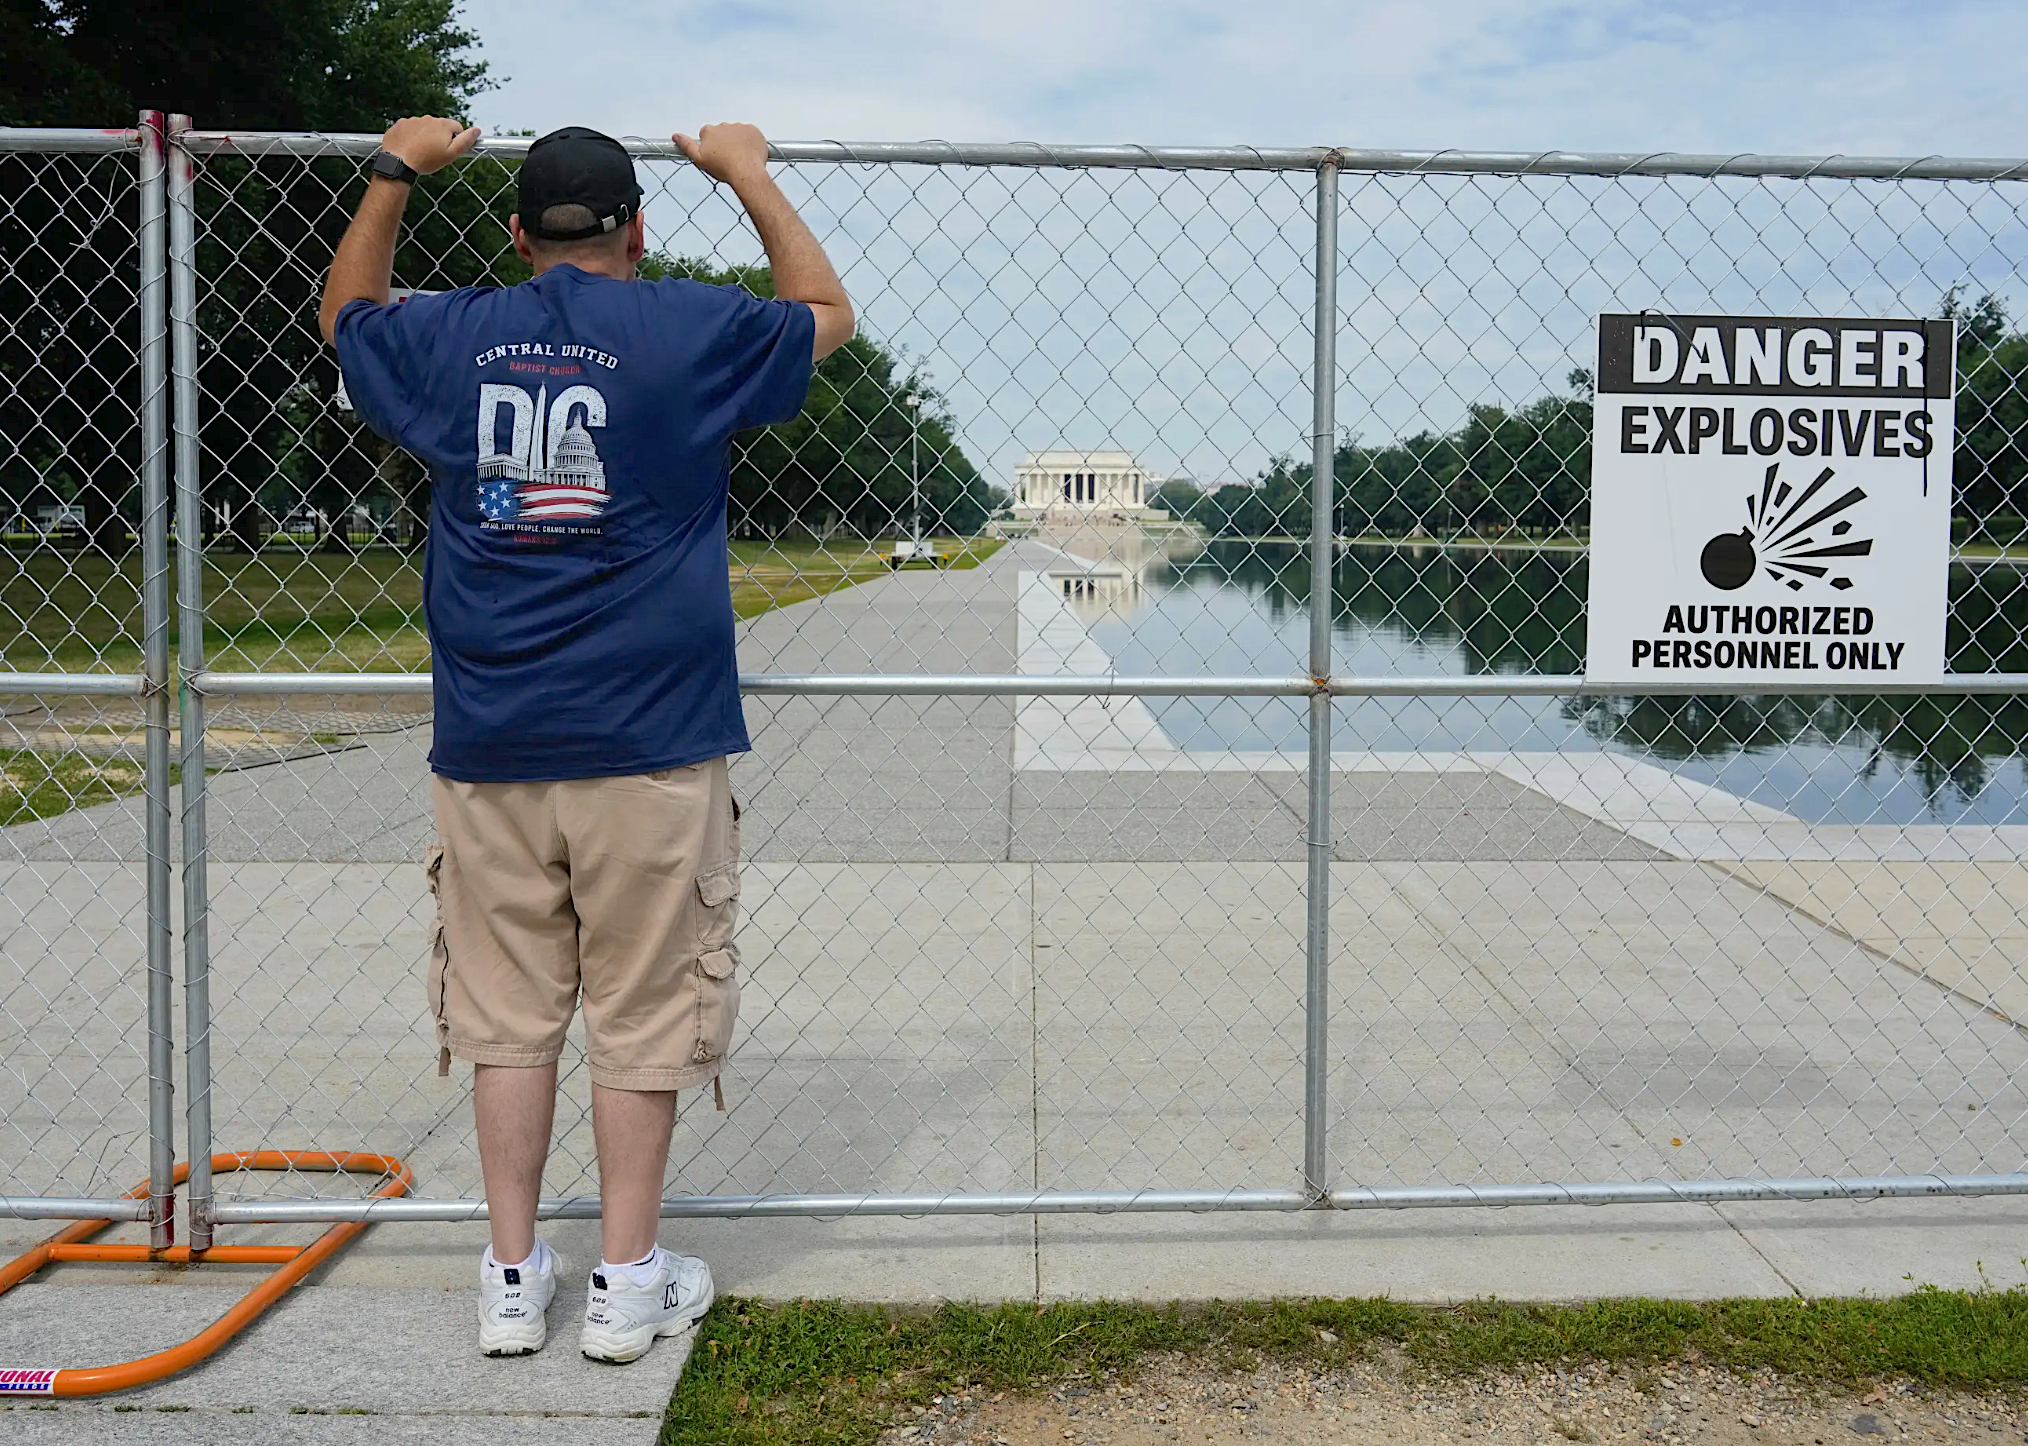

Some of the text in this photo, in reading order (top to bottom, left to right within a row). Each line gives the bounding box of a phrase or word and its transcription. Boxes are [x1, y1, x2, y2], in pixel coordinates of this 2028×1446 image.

[475, 342, 619, 370] CENTRAL UNITED
[509, 361, 582, 375] BAPTIST CHURCH
[1632, 325, 1926, 388] DANGER
[1620, 406, 1934, 458] EXPLOSIVES
[501, 523, 516, 531] LOVE
[517, 524, 541, 532] PEOPLE.
[542, 526, 566, 534] CHANGE
[567, 527, 579, 535] THE
[580, 527, 604, 535] WORLD.
[1662, 605, 1874, 635] AUTHORIZED
[1631, 640, 1905, 670] PERSONNEL ONLY
